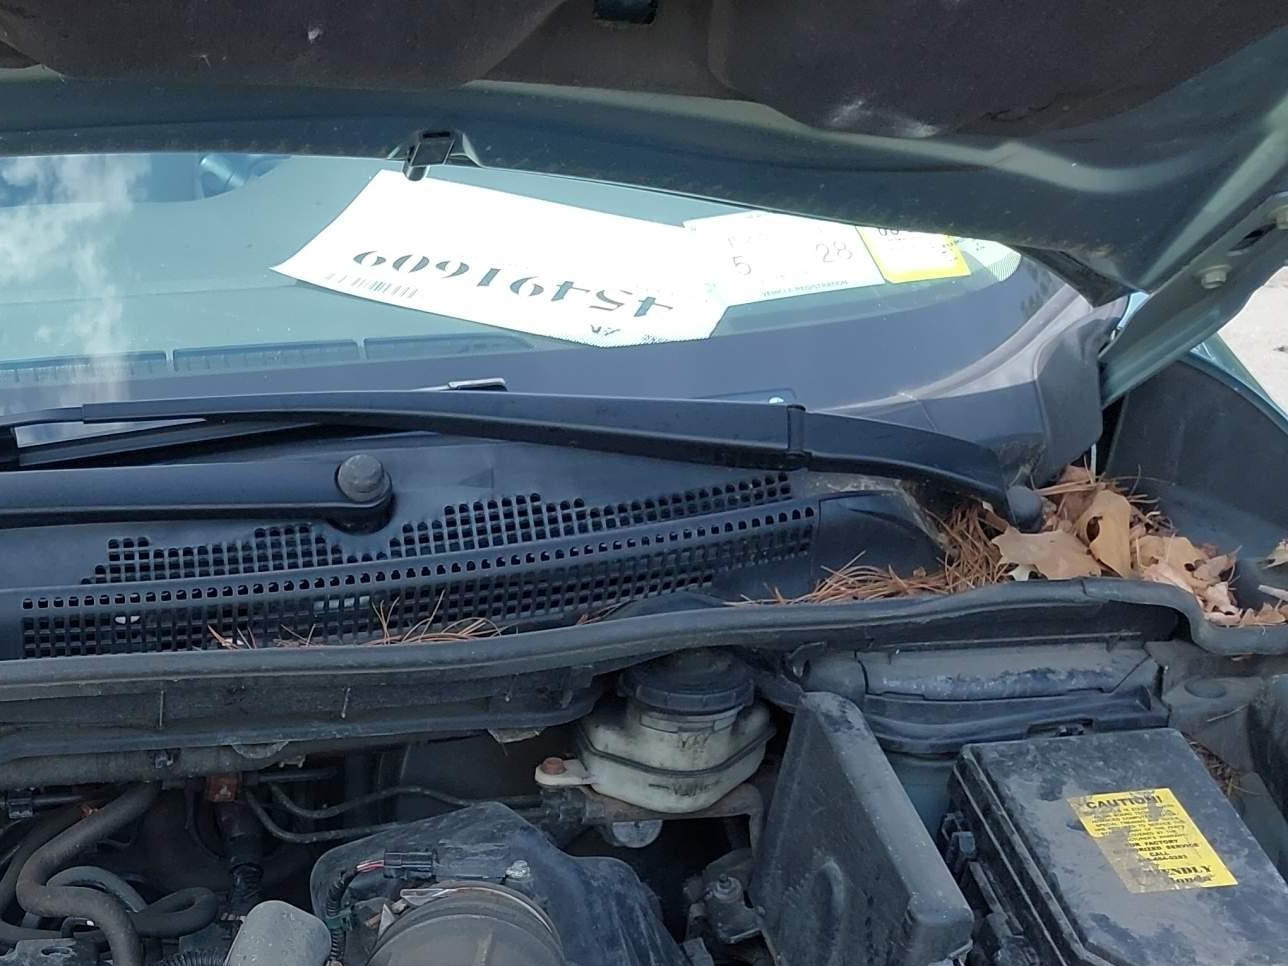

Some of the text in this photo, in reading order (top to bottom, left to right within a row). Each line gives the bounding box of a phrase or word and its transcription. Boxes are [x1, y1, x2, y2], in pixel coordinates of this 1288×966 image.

[815, 241, 853, 263] 28
[732, 255, 752, 276] 5
[352, 251, 673, 318] 45491609
[1086, 795, 1162, 810] CAUTION!
